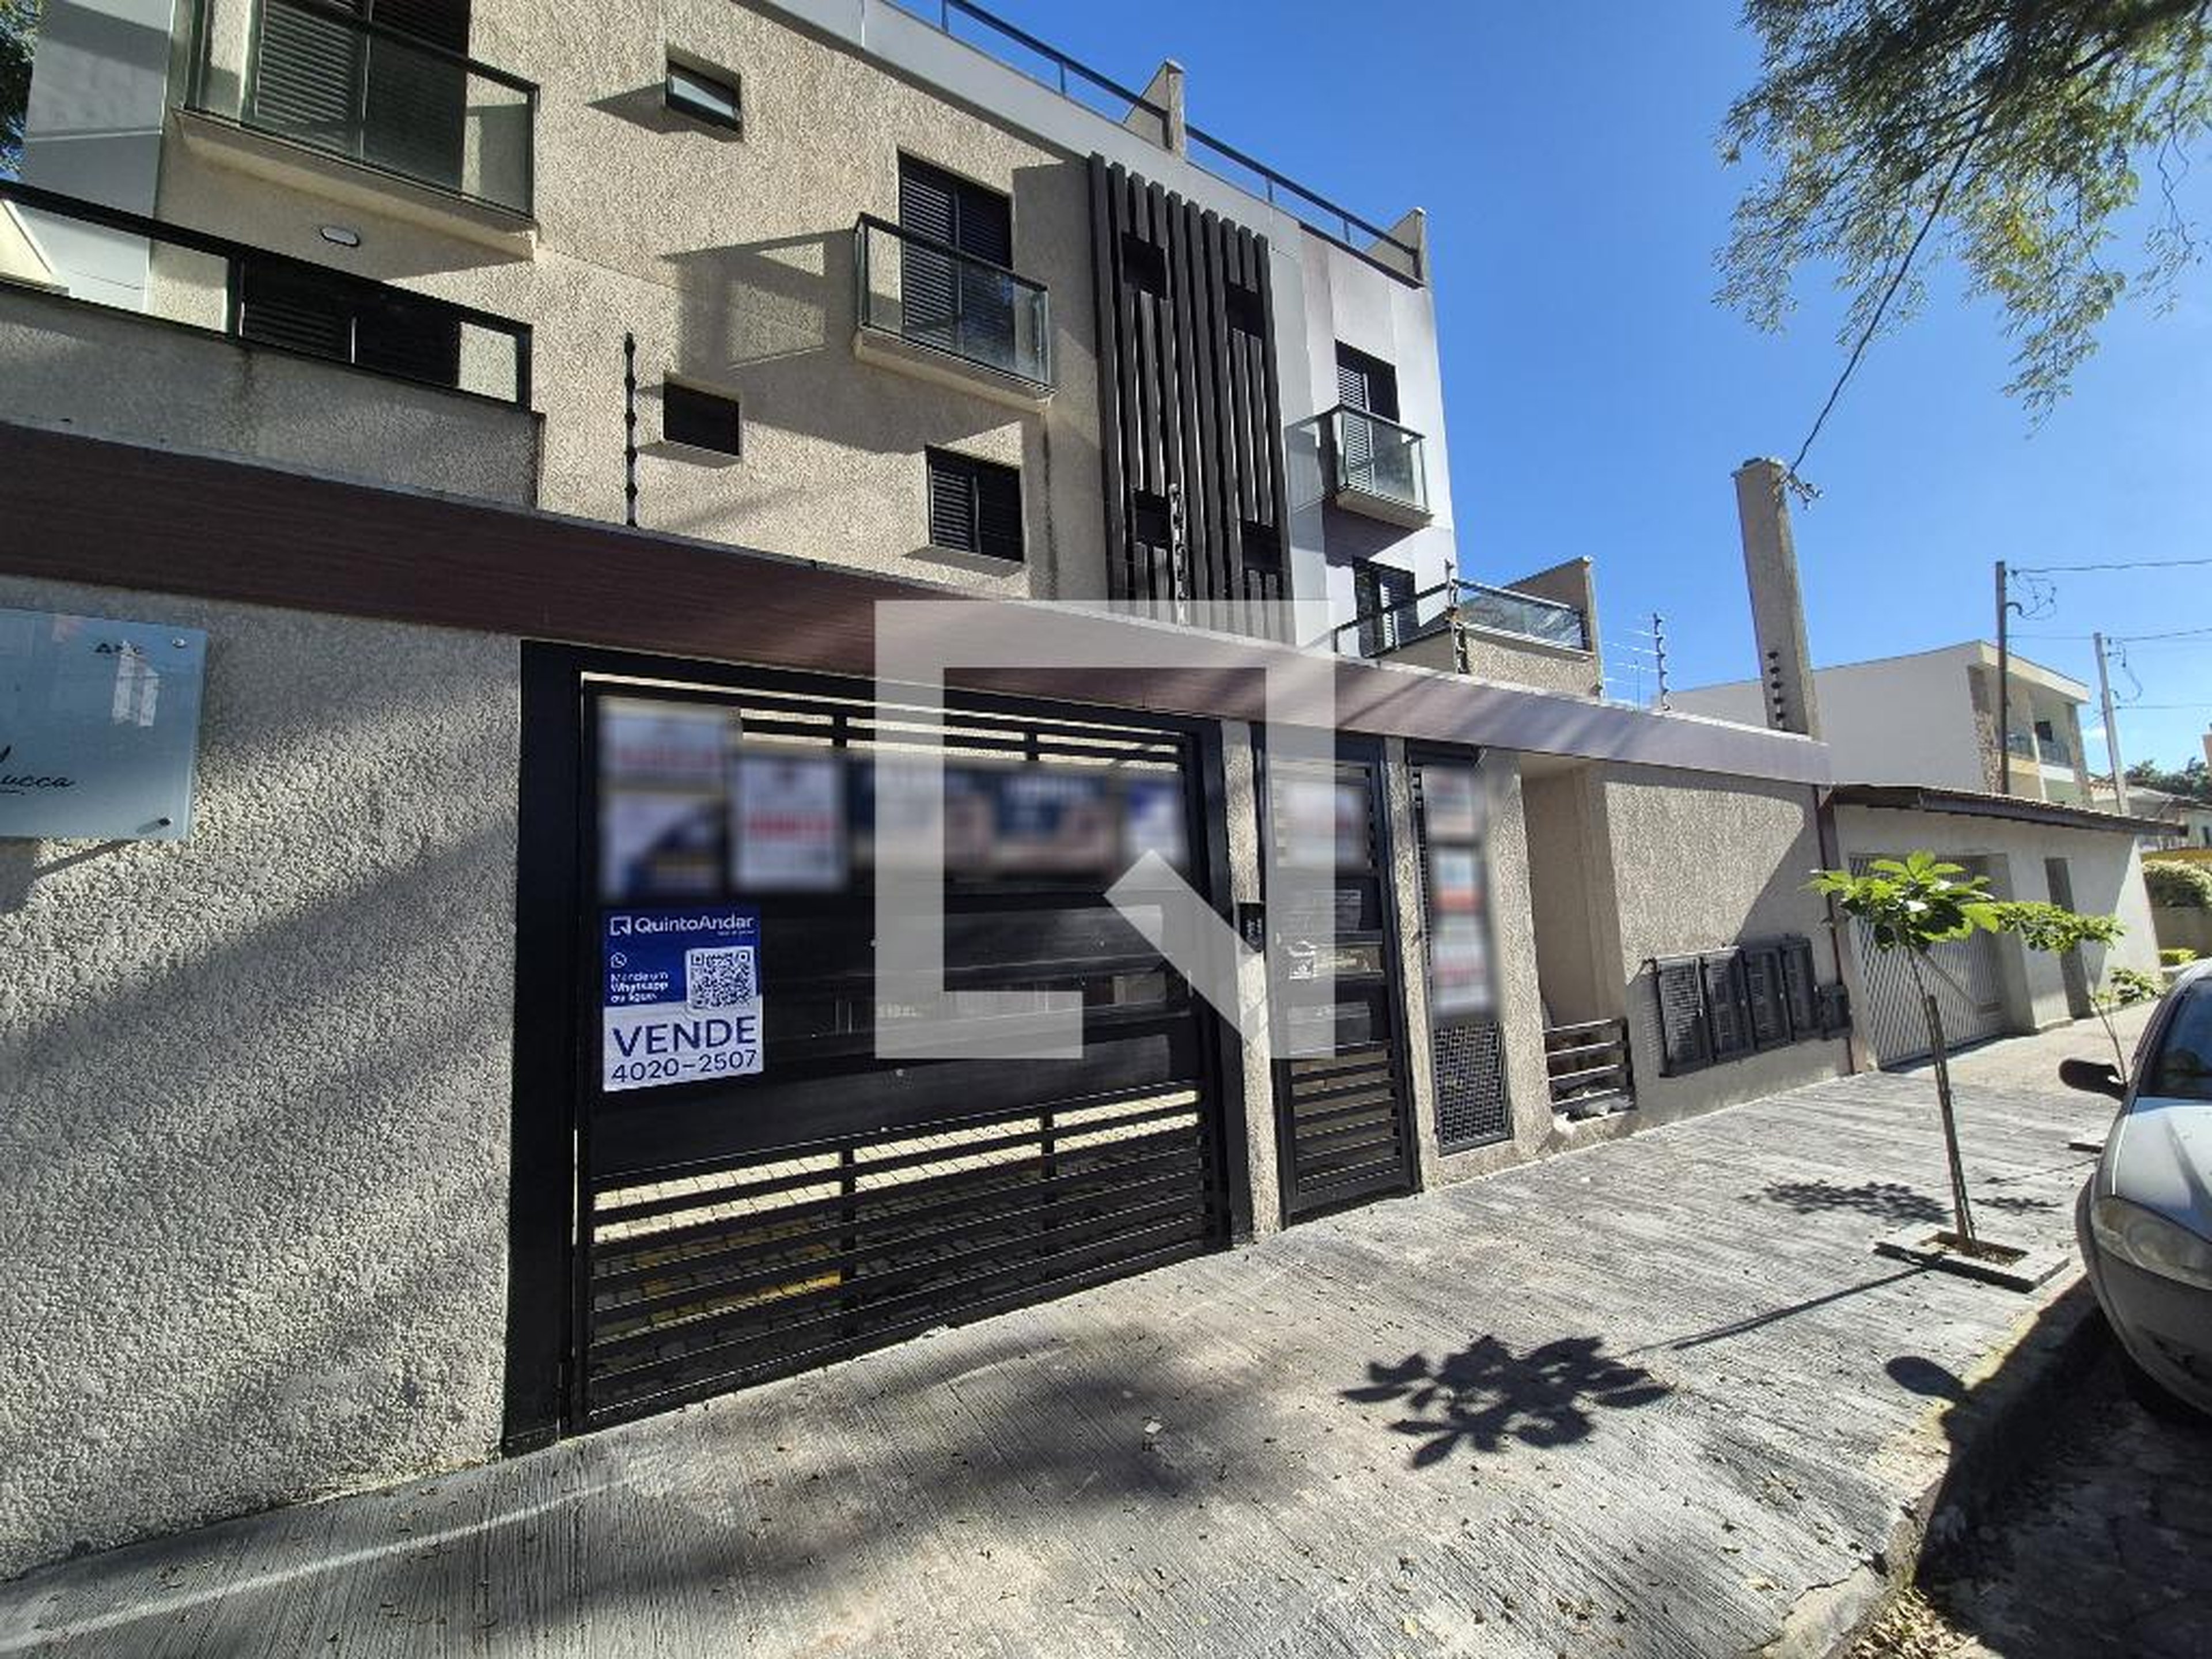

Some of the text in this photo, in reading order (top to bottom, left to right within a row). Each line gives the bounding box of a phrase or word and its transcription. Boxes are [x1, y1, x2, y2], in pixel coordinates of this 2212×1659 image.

[0, 775, 75, 787] ucca
[634, 914, 753, 933] QuintoAndar
[612, 1016, 756, 1056] VENDE
[611, 1050, 756, 1082] 4020-2507
